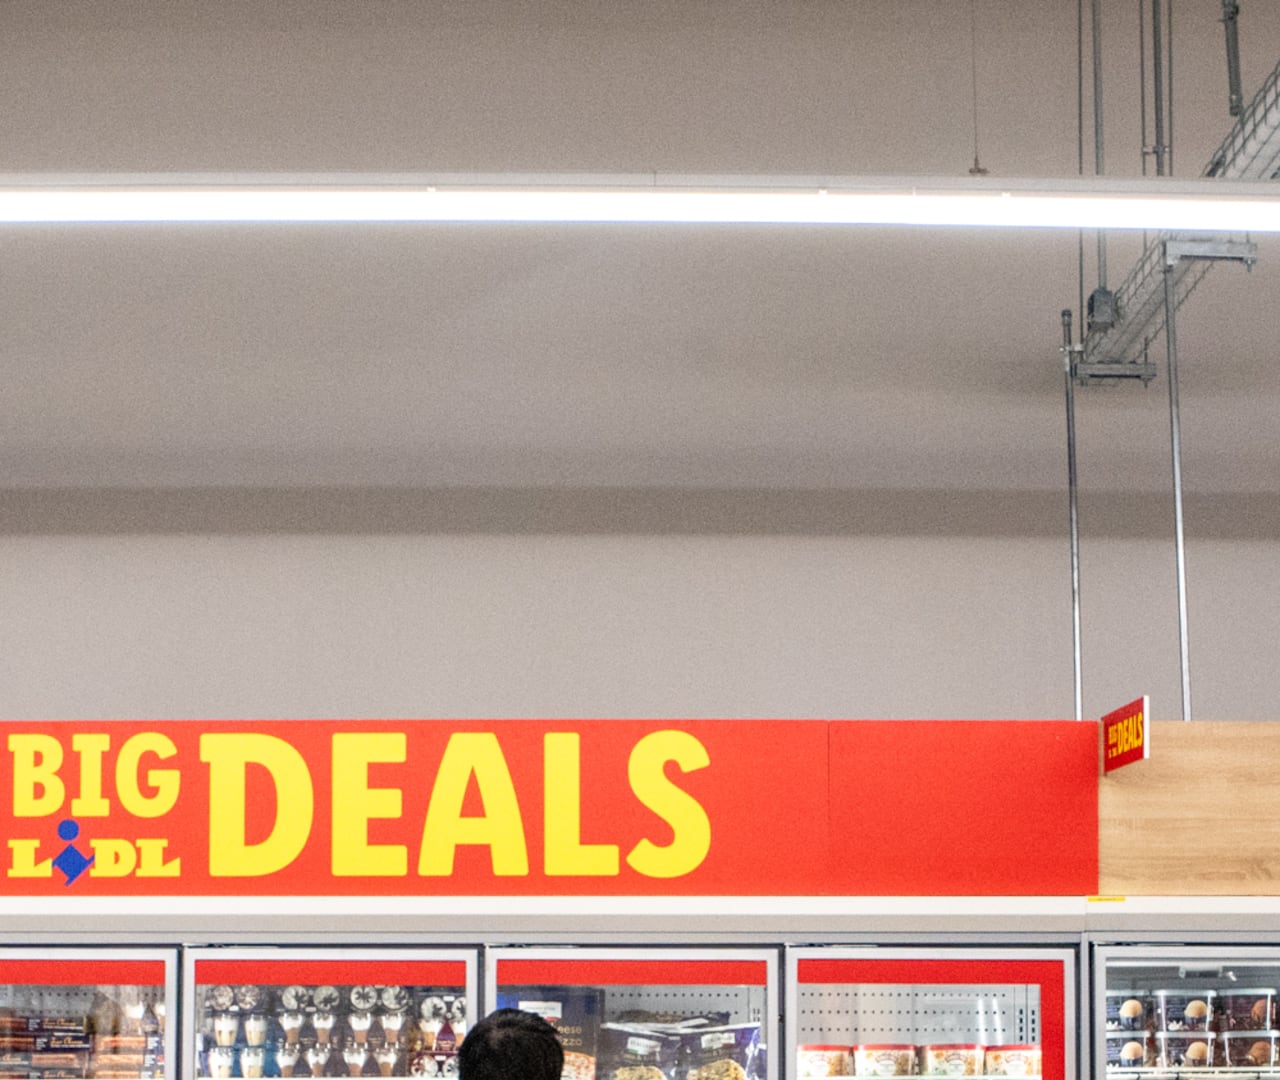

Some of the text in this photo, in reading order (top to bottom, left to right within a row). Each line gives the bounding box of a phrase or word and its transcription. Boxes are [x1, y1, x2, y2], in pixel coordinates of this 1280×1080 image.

[1117, 712, 1143, 755] DEALS
[8, 729, 711, 879] BIG DEALS
